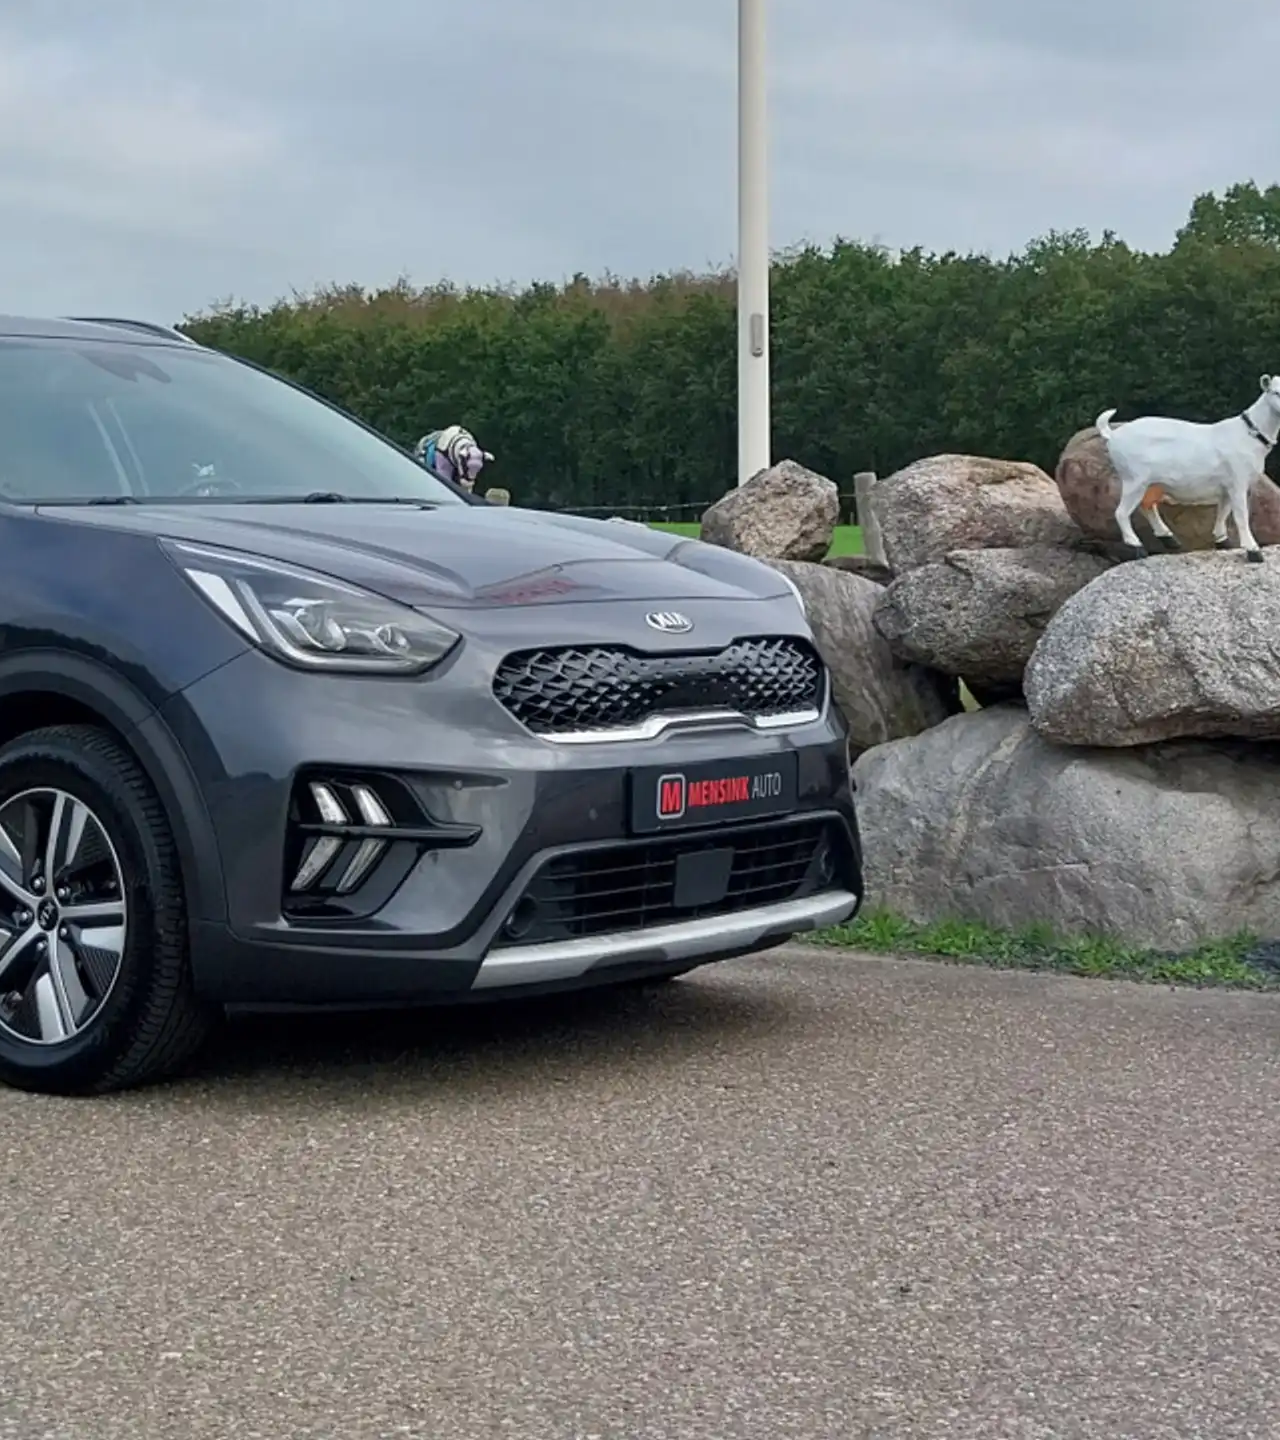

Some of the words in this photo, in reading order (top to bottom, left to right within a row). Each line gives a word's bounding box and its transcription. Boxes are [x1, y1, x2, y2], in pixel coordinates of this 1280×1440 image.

[662, 781, 682, 813] M
[687, 776, 750, 807] MENSINK
[751, 772, 782, 799] AUTO
